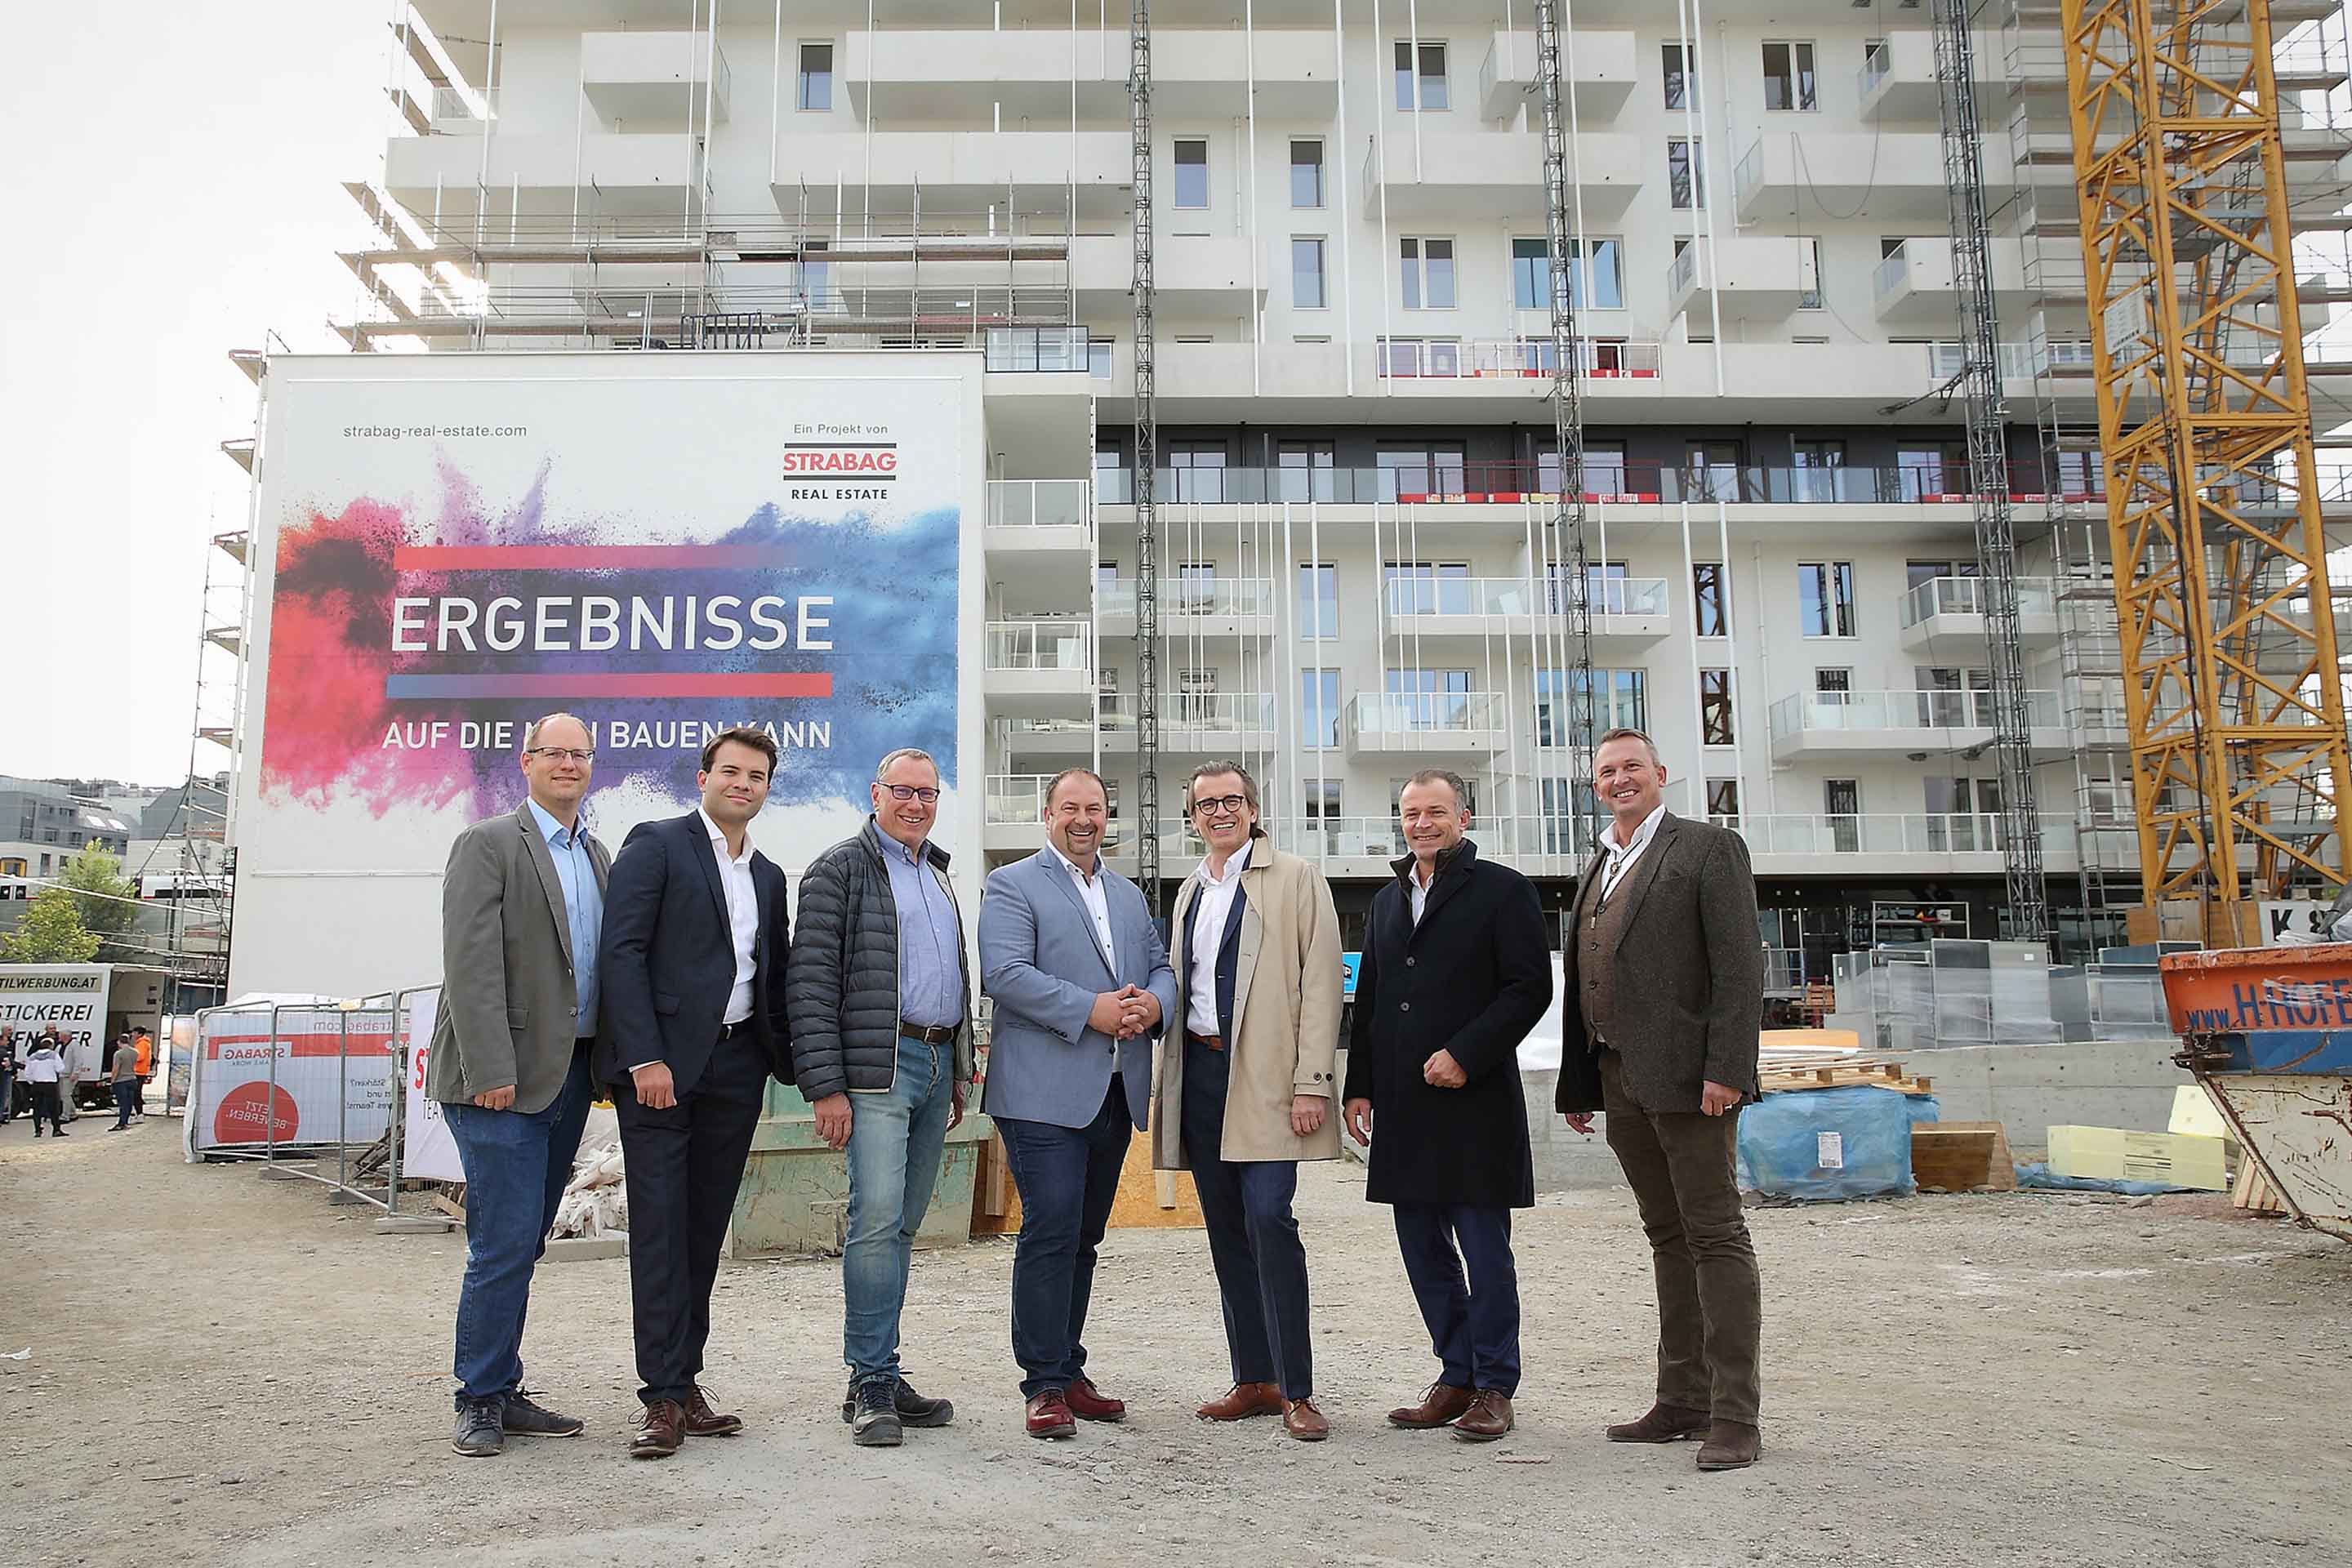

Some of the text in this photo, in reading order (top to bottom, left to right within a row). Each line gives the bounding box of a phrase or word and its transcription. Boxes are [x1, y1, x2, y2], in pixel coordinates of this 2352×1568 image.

[342, 425, 528, 439] strabag-real-estate.com
[794, 424, 889, 435] Ein Projekt von
[783, 452, 897, 471] STRABAG
[791, 489, 888, 500] REAL ESTATE
[391, 595, 835, 652] ERGEBNISSE
[381, 721, 451, 750] AUF
[460, 721, 514, 749] DIE
[609, 720, 723, 749] BAUEN
[737, 720, 831, 748] ANN
[423, 1099, 443, 1120] TEA
